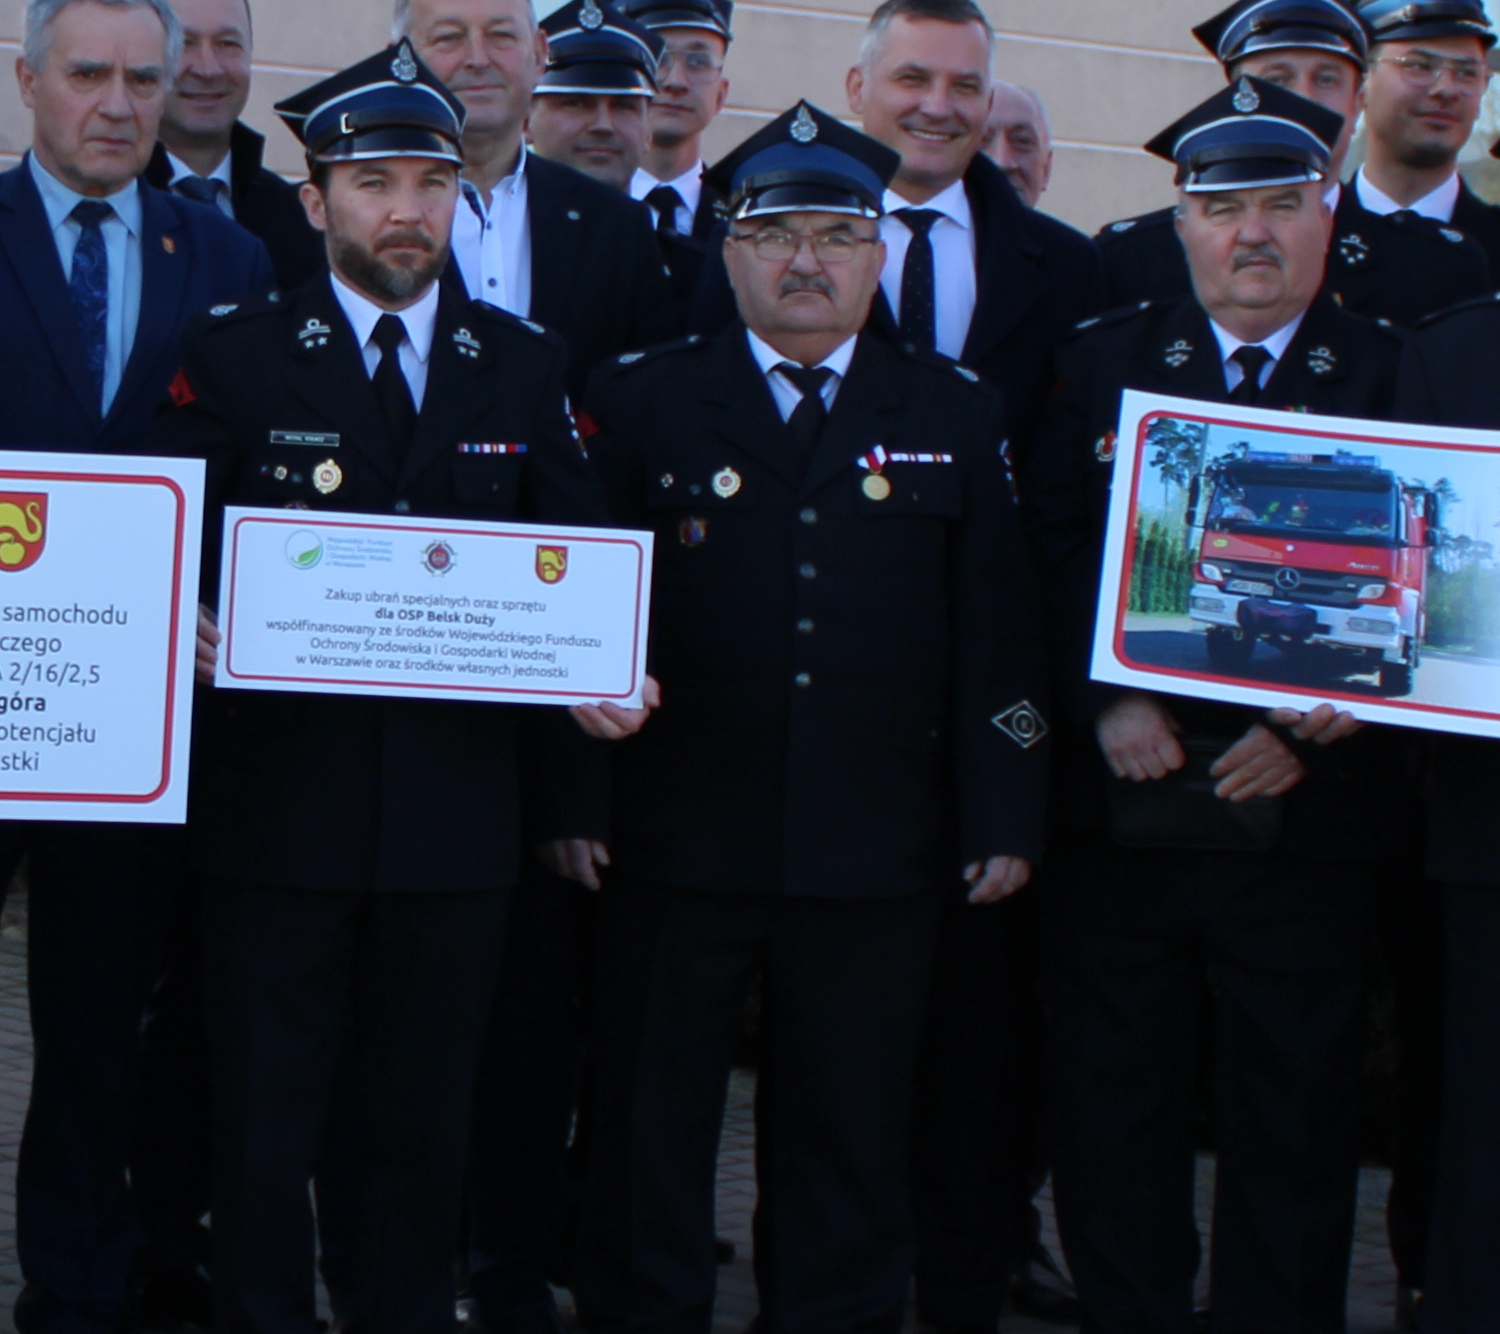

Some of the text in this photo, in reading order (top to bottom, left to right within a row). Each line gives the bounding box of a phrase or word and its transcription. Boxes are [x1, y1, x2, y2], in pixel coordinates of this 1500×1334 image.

[2, 602, 128, 625] samochodu
[325, 588, 546, 614] Zakup ubrań specjalnych oraz sprzętu
[374, 607, 496, 627] dla OSP Belsk Duży
[266, 618, 602, 648] współfinansowany ze środków Wojewódzkiego Funduszu
[310, 637, 557, 664] Ochrony Środowiska i Gospodarki Wodnej
[9, 660, 100, 687] 2/16/2,5
[295, 653, 569, 679] w Warszawie oraz środków własnych jednostki
